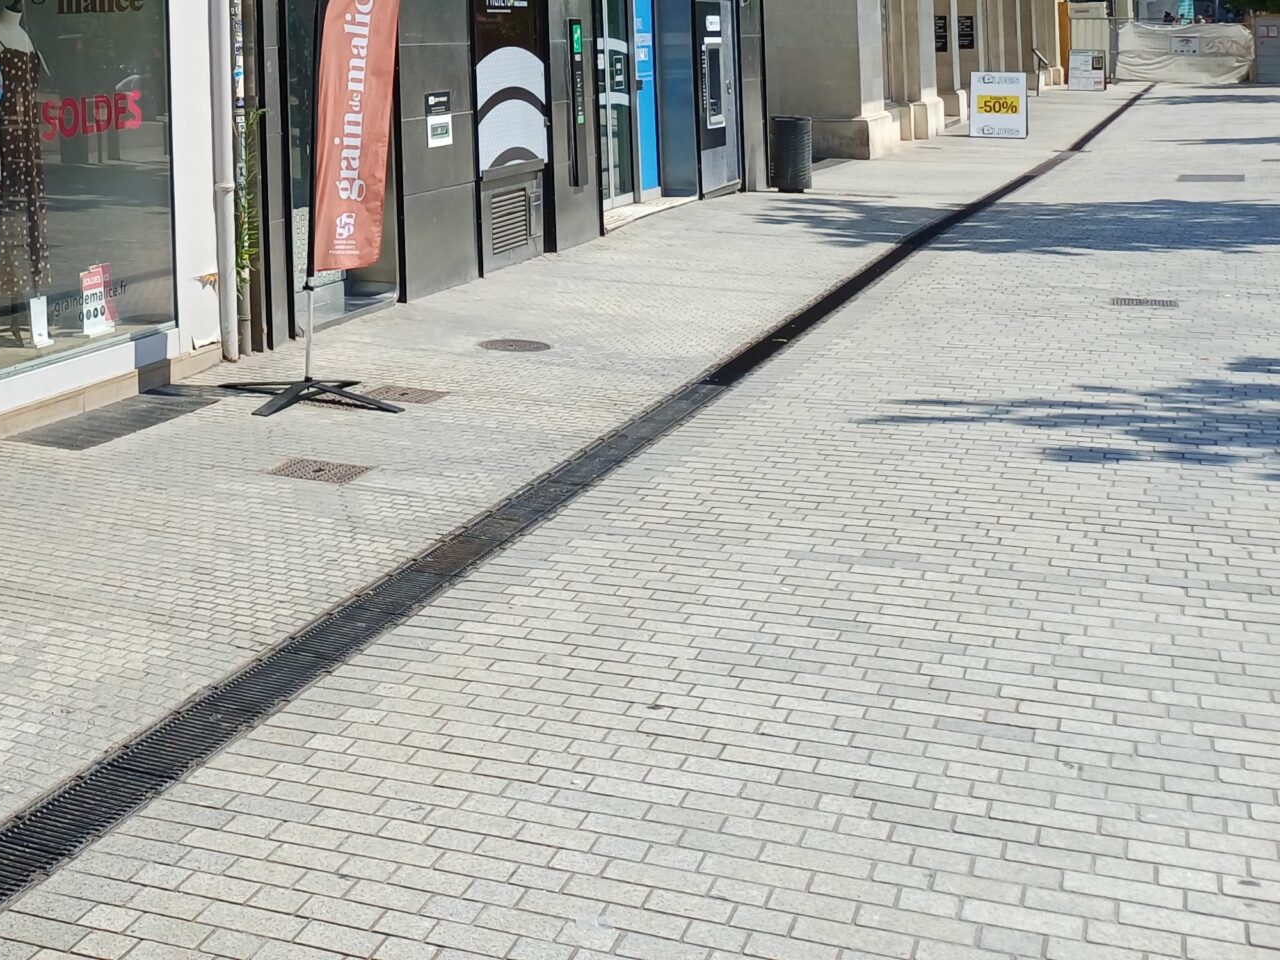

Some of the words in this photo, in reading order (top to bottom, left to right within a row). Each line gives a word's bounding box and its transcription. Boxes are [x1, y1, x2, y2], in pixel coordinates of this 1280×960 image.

[42, 89, 143, 141] SOLDES
[348, 92, 362, 112] de
[978, 100, 1018, 114] -50%
[334, 111, 367, 202] grain
[54, 280, 128, 317] graindemalice.fr
